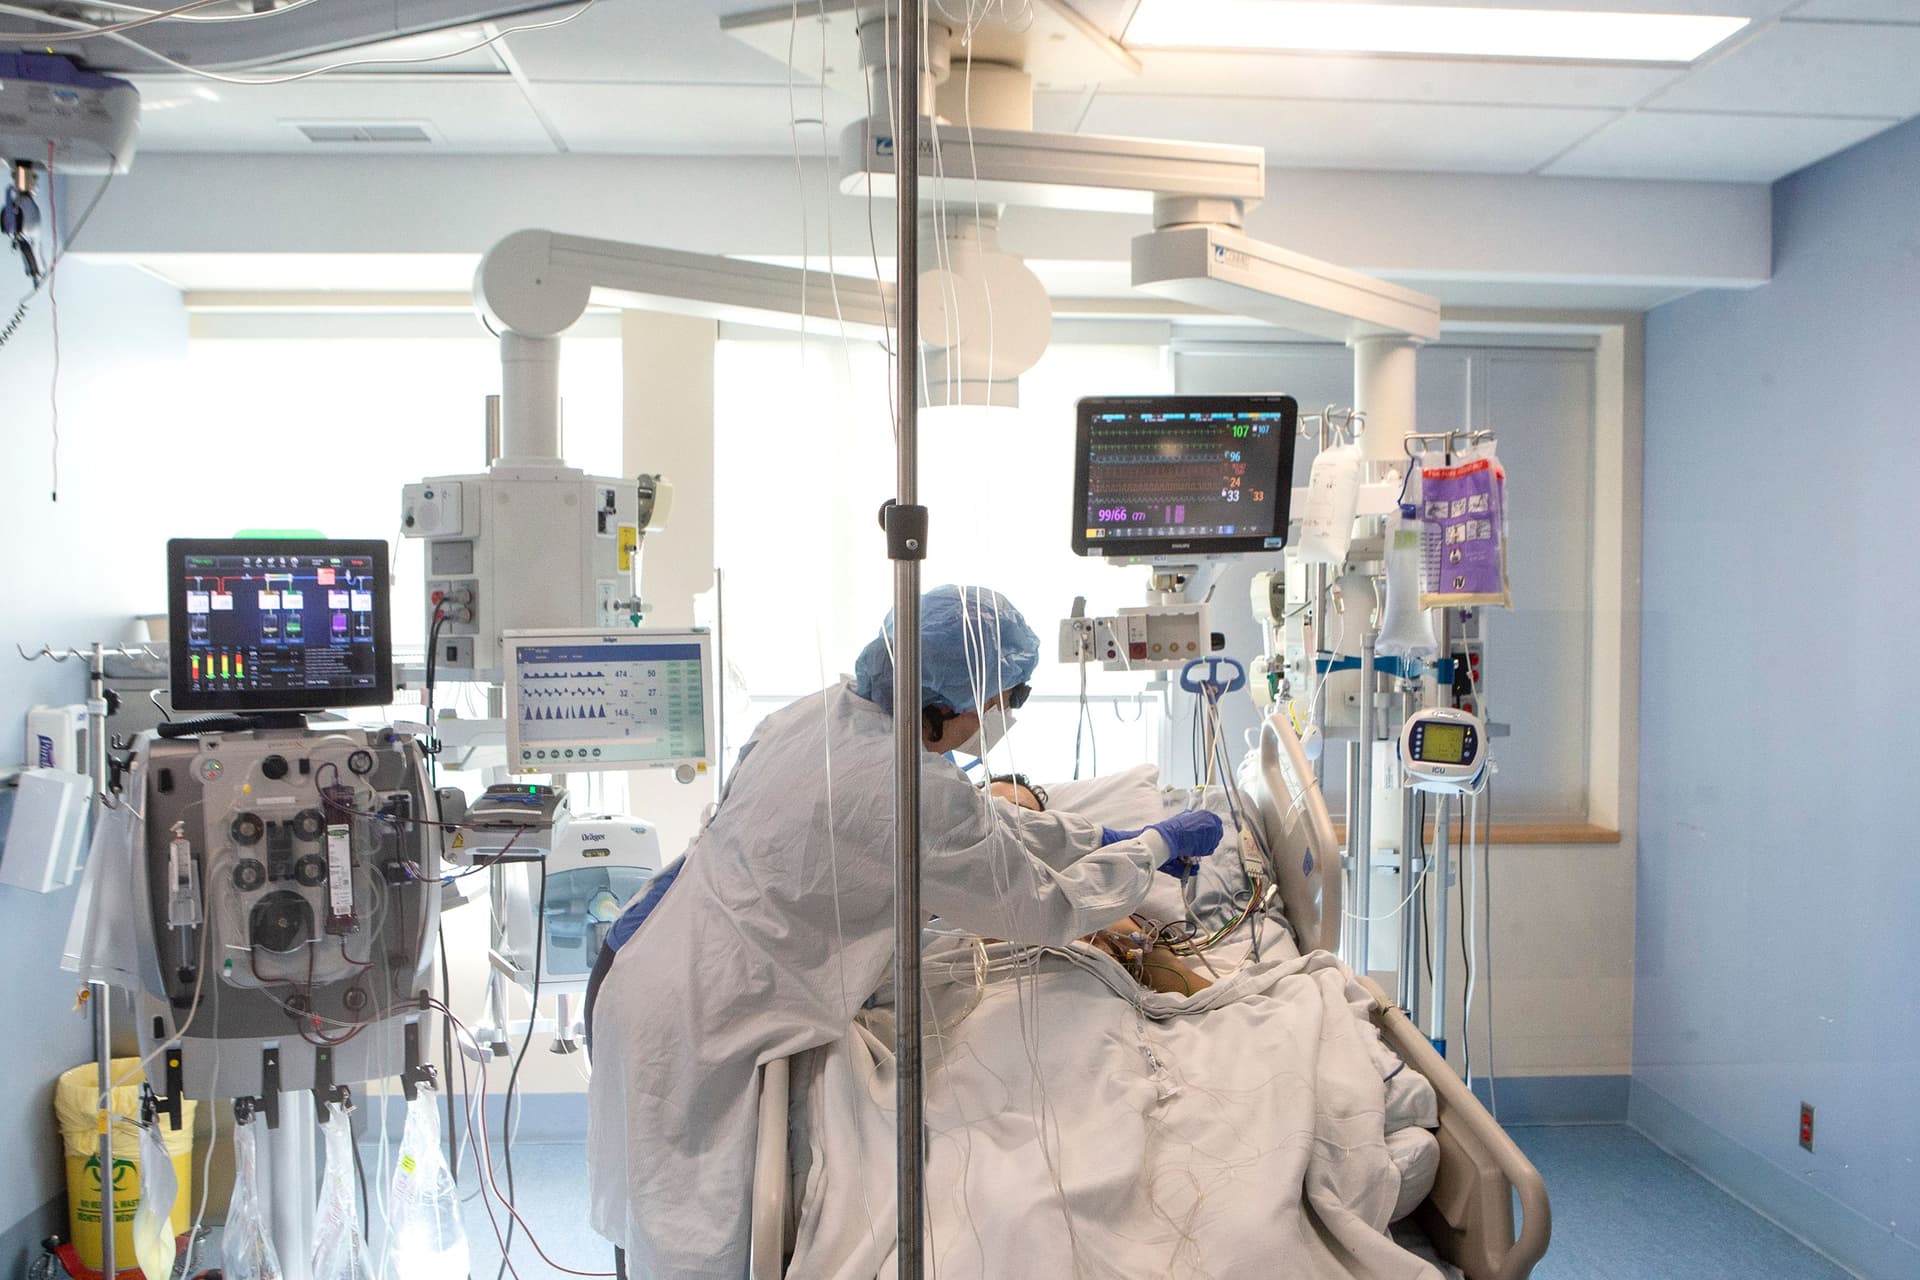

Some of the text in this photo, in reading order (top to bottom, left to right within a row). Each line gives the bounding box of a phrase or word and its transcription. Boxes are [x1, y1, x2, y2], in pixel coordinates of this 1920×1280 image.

[1233, 424, 1270, 438] 107 107
[1230, 451, 1241, 462] 96
[1230, 477, 1241, 488] 24
[1226, 489, 1264, 502] 33 33
[1098, 509, 1127, 521] 99/66
[615, 670, 627, 678] 474
[1431, 767, 1446, 775] ICU
